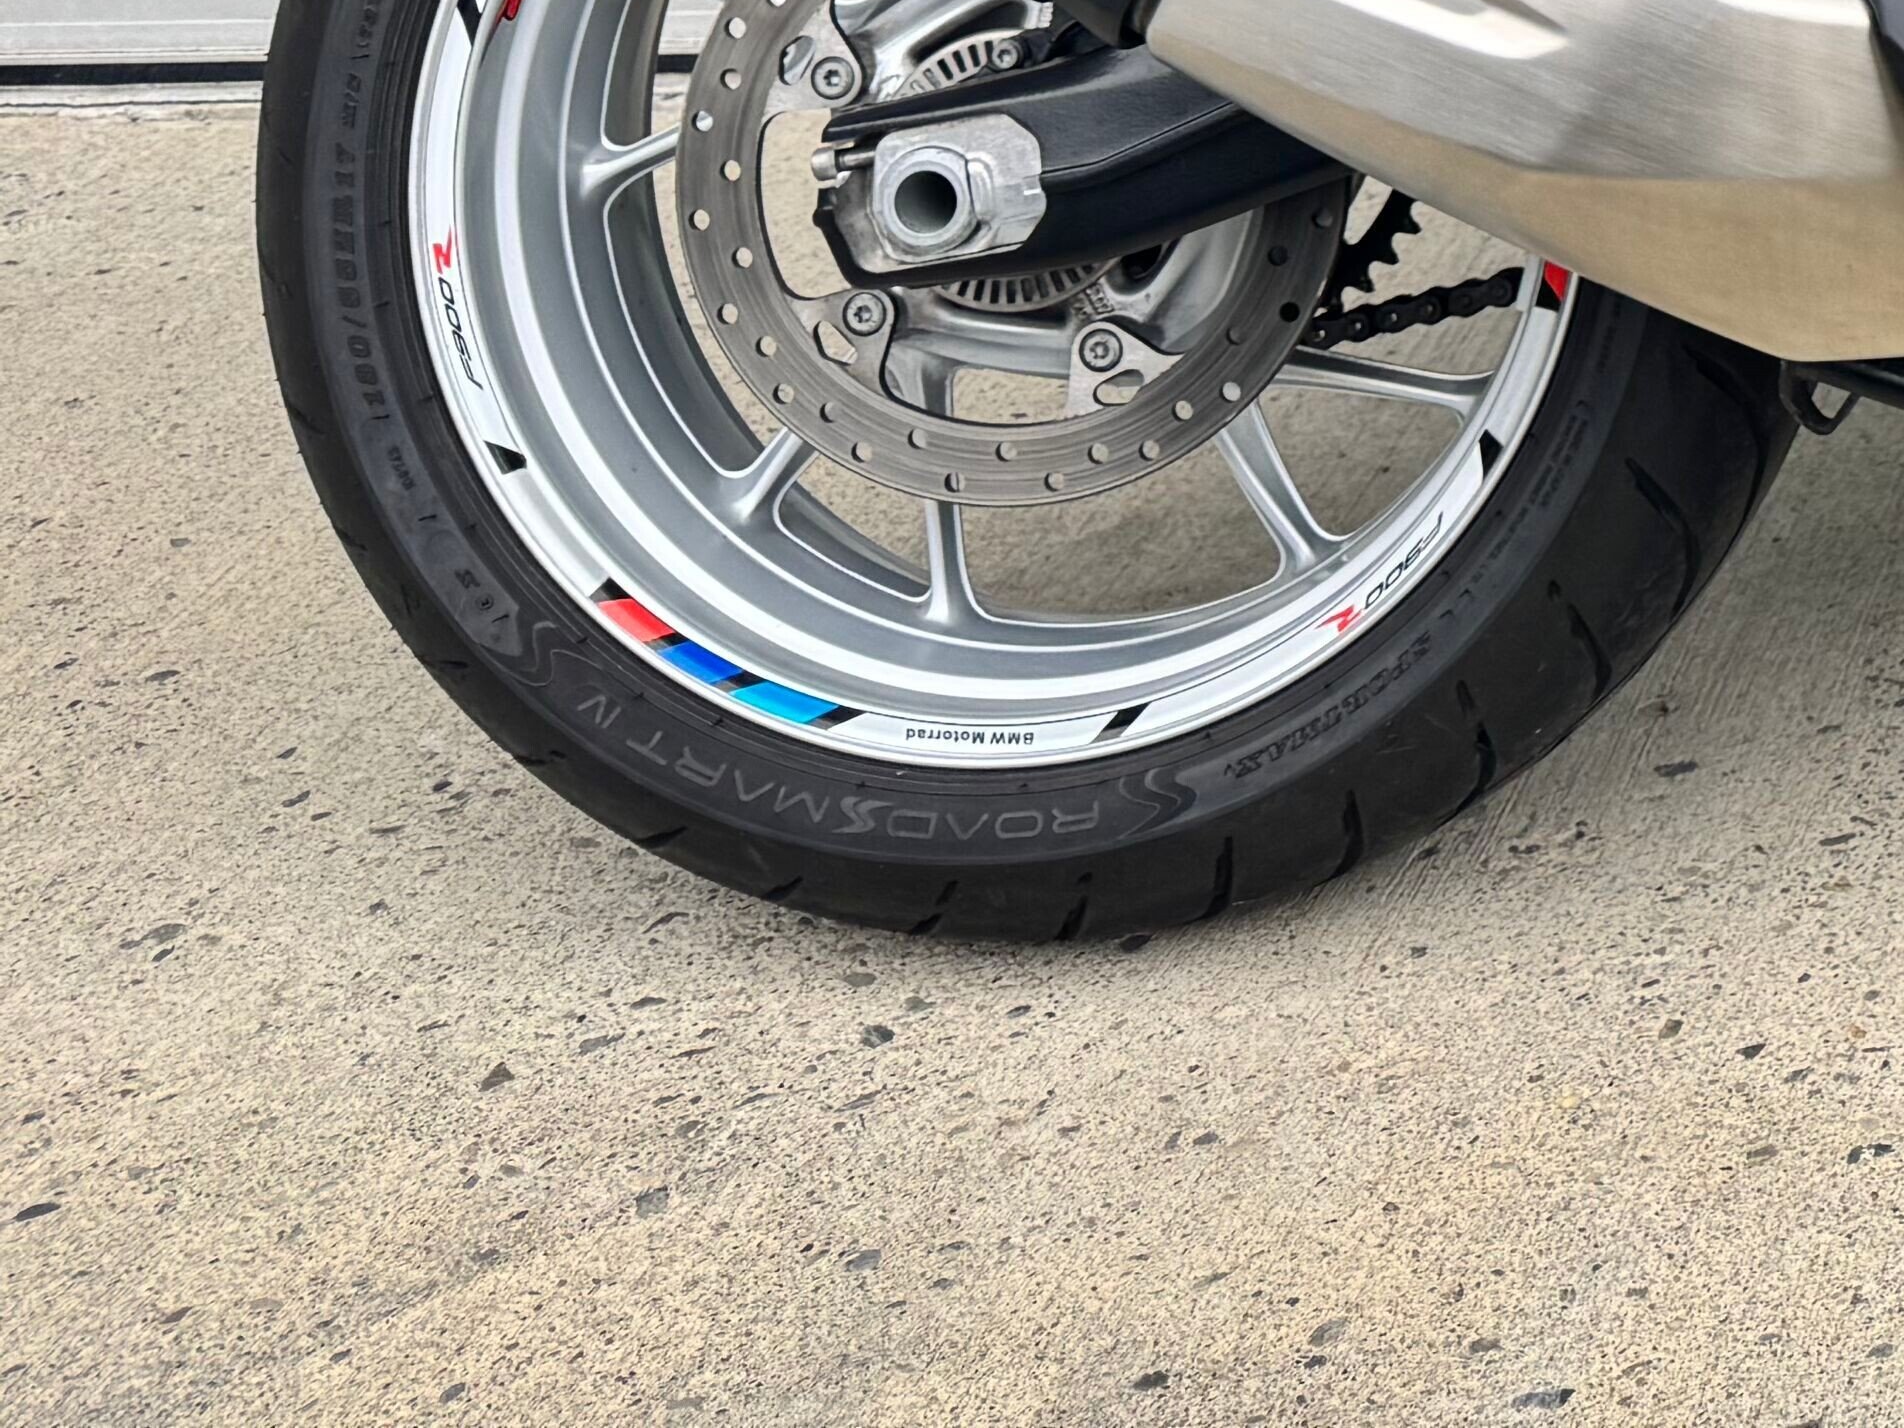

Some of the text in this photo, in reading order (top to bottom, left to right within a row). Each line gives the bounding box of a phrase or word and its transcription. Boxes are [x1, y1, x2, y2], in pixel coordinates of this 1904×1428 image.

[432, 224, 484, 391] F900R
[1314, 511, 1444, 632] F900R
[576, 694, 1101, 841] ROADSMART IV
[904, 726, 1035, 747] BMW Motorrad
